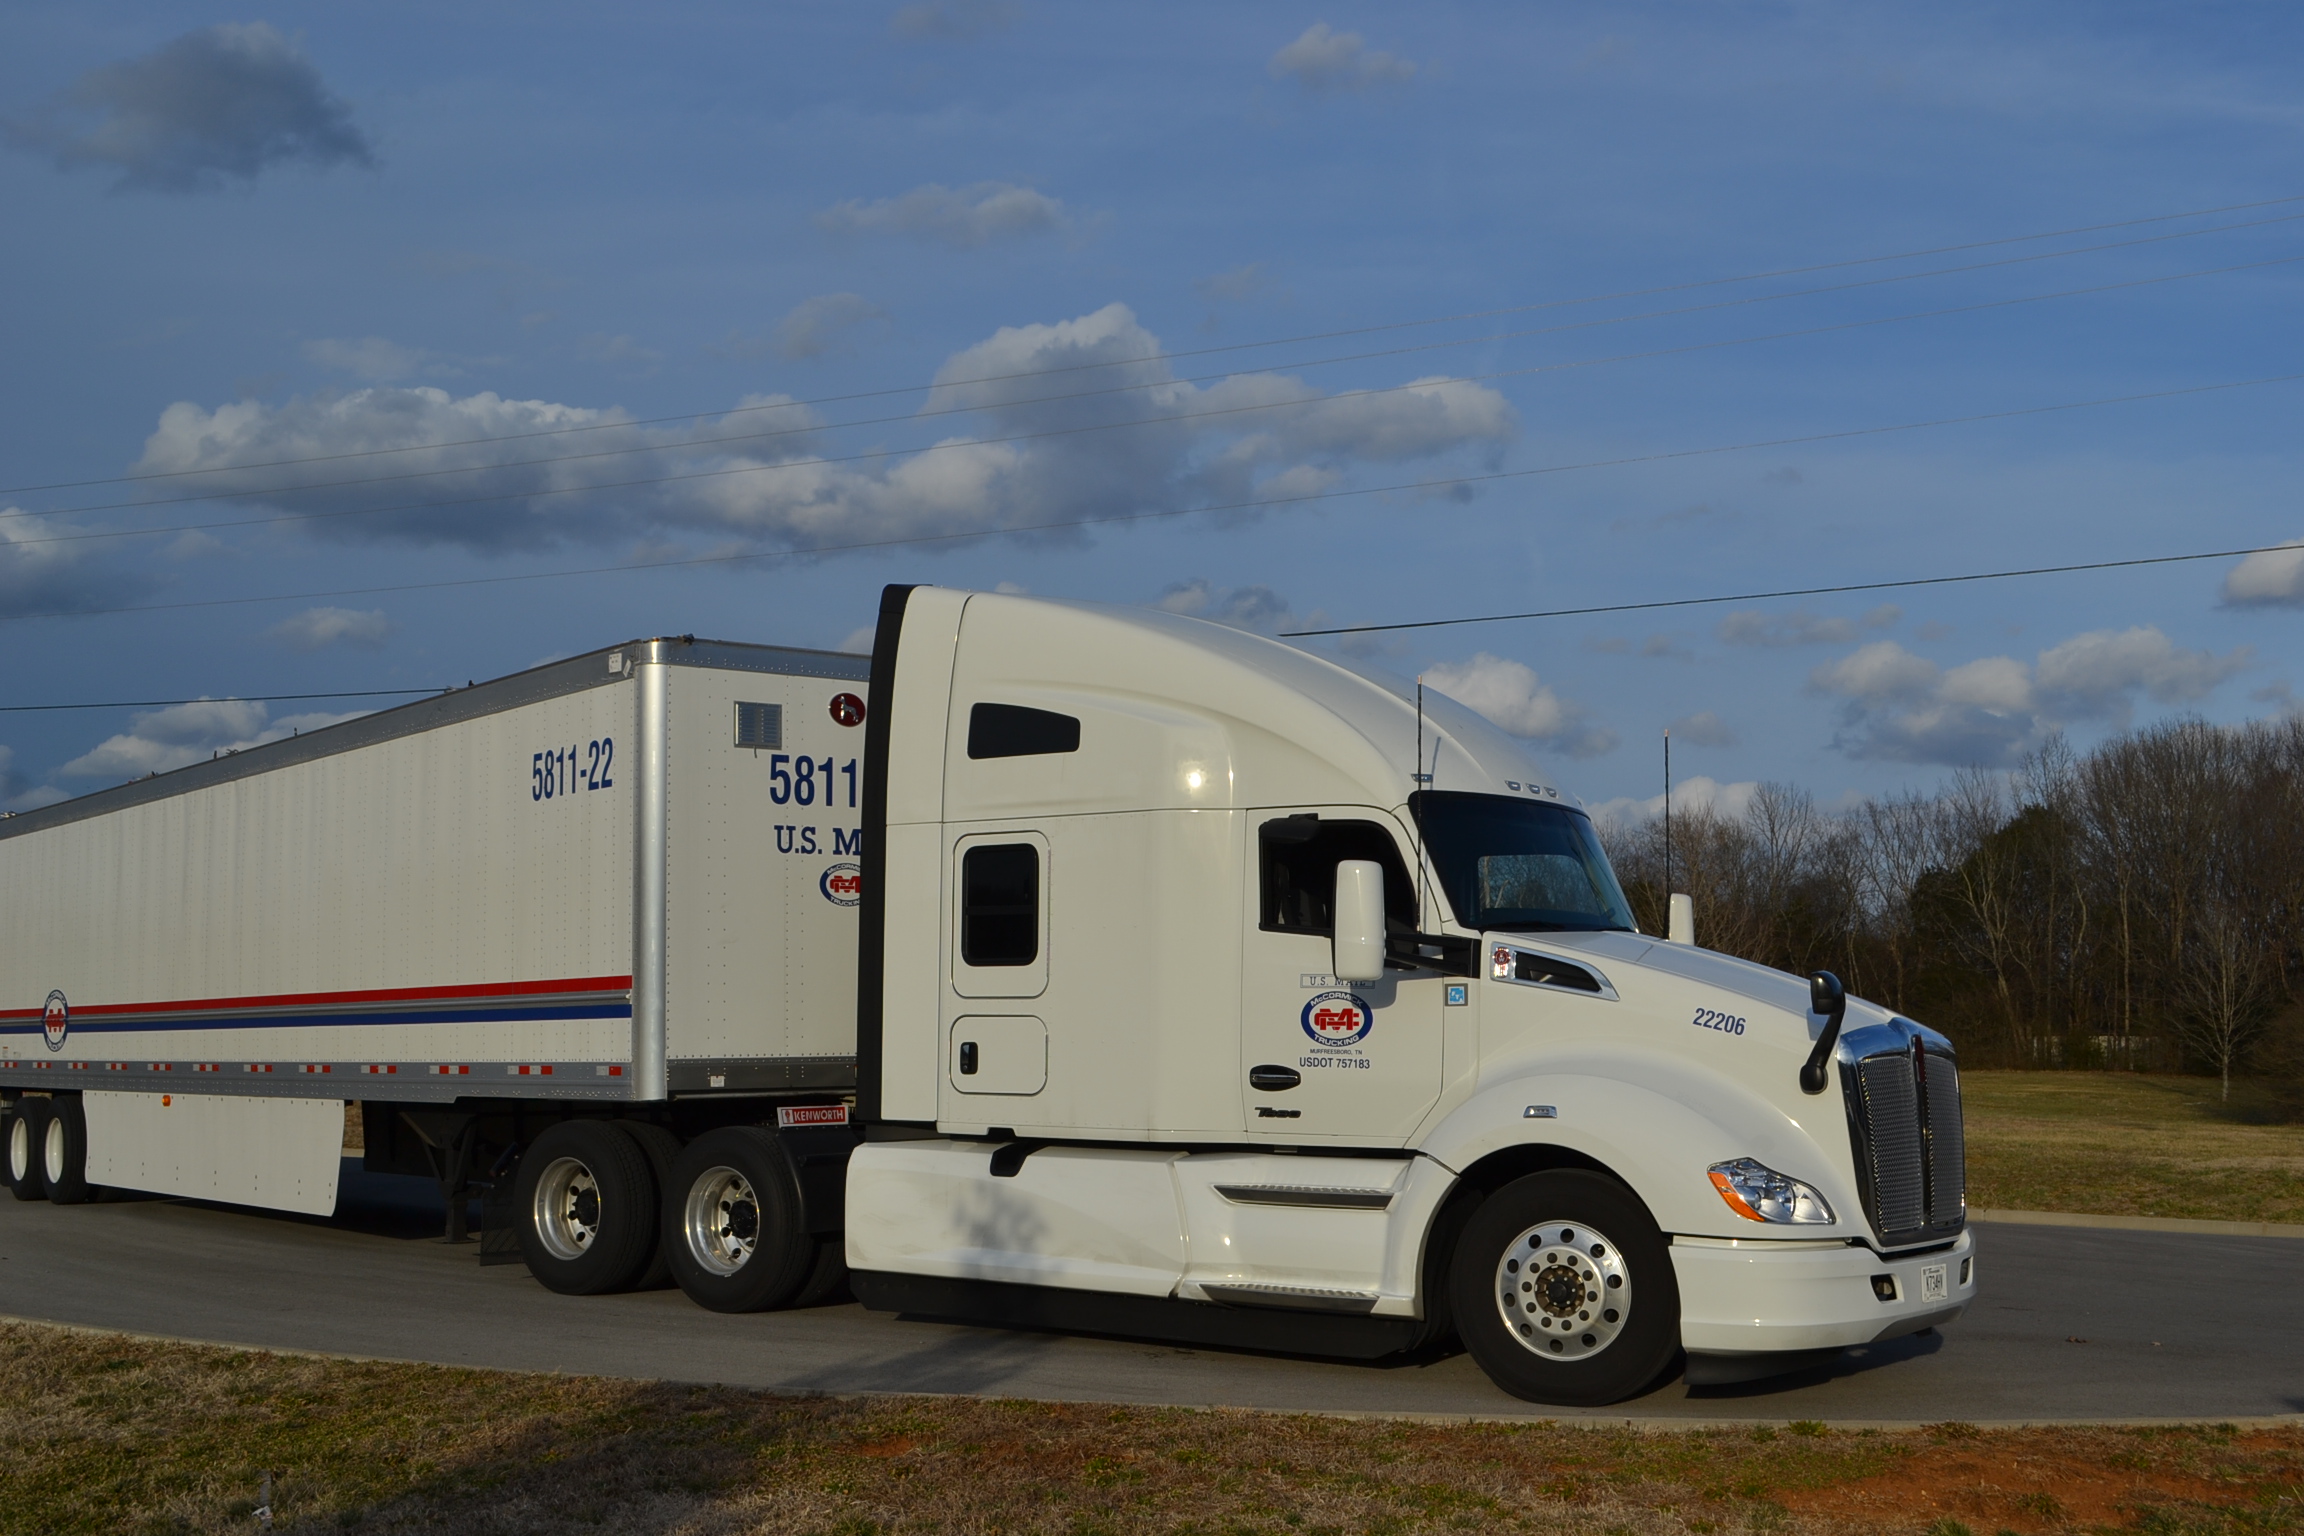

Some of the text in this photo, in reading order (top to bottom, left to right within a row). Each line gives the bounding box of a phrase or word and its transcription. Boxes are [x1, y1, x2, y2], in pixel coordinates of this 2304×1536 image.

[532, 737, 614, 801] 5811-22
[769, 754, 857, 808] 5811
[774, 825, 822, 854] U.S.
[1309, 976, 1329, 986] U.S.
[1692, 1008, 1746, 1036] 22206
[1313, 1033, 1360, 1046] TRUCKING
[1299, 1056, 1371, 1070] USDOT 757183
[794, 1109, 843, 1121] KENWORTH
